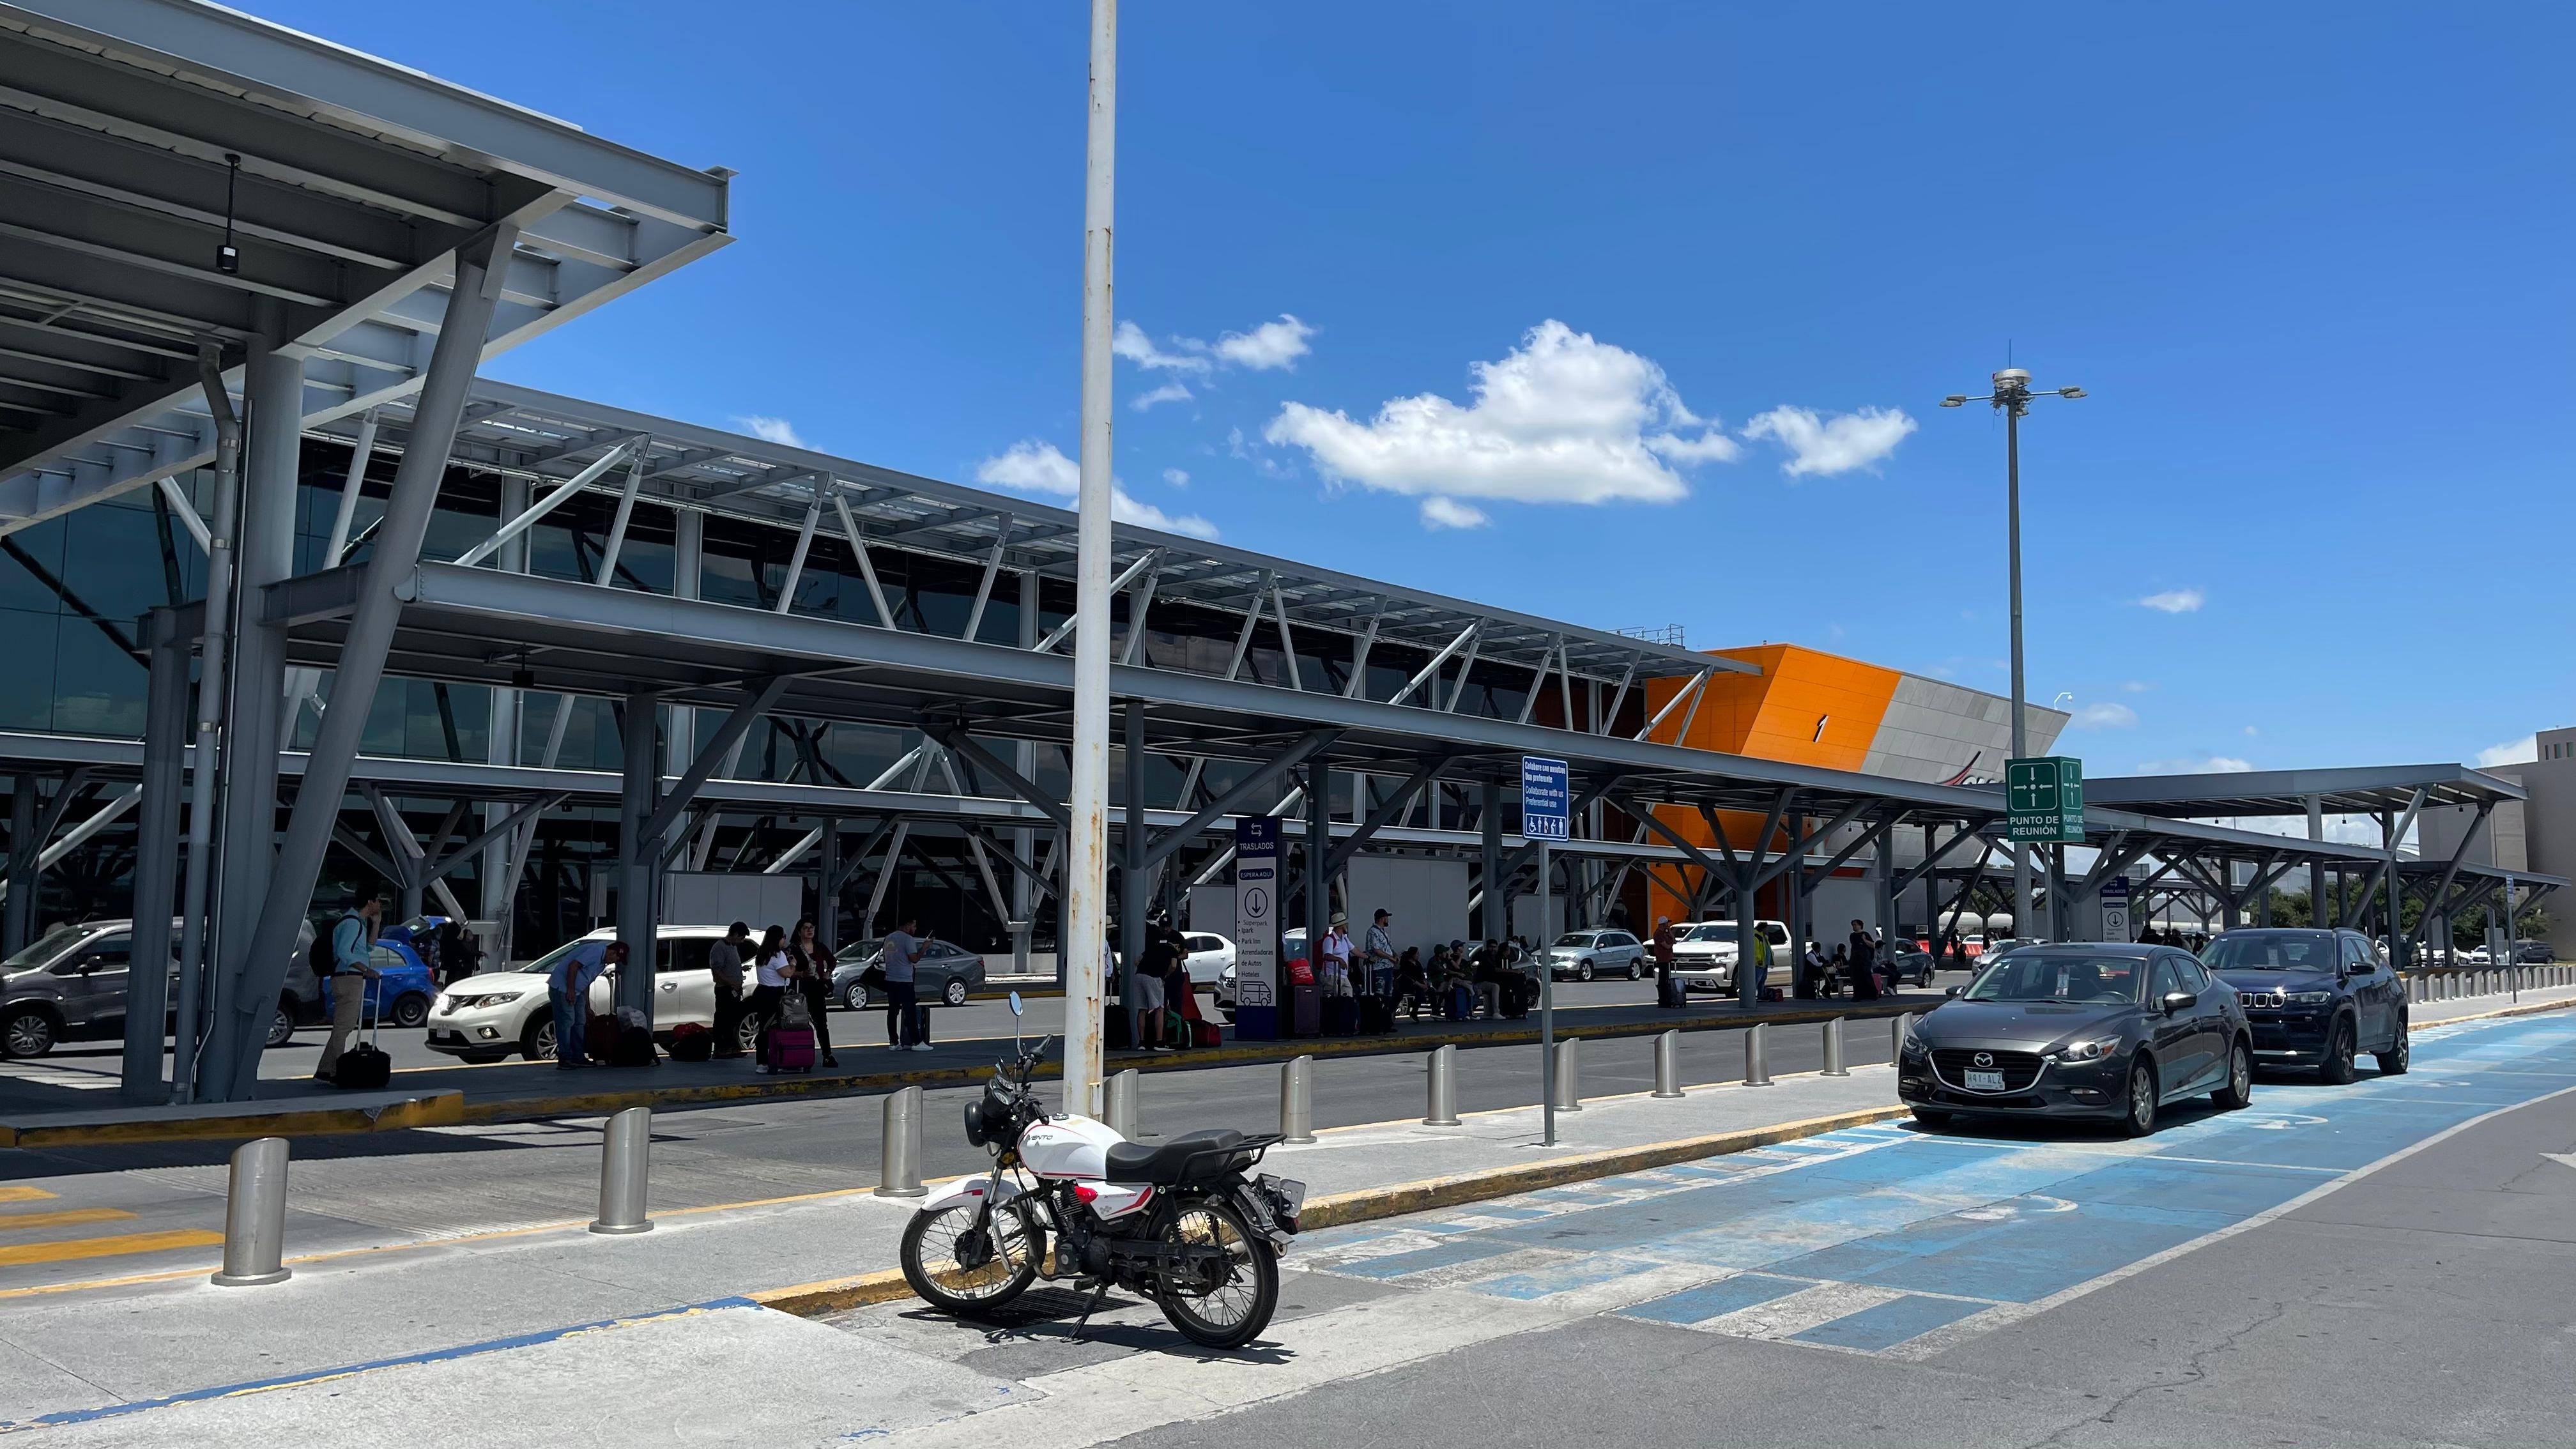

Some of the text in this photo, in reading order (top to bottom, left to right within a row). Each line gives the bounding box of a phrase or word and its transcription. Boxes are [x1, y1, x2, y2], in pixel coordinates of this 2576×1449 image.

[1813, 714, 1828, 742] 1
[1525, 785, 1548, 796] Collaborate
[1549, 788, 1558, 797] with
[1525, 796, 1549, 807] Preferential
[2010, 815, 2059, 825] PUNTO DE
[2064, 814, 2077, 823] PUNTO
[2012, 825, 2057, 836] REUNIÓN
[1239, 841, 1274, 850] TRASLADOS
